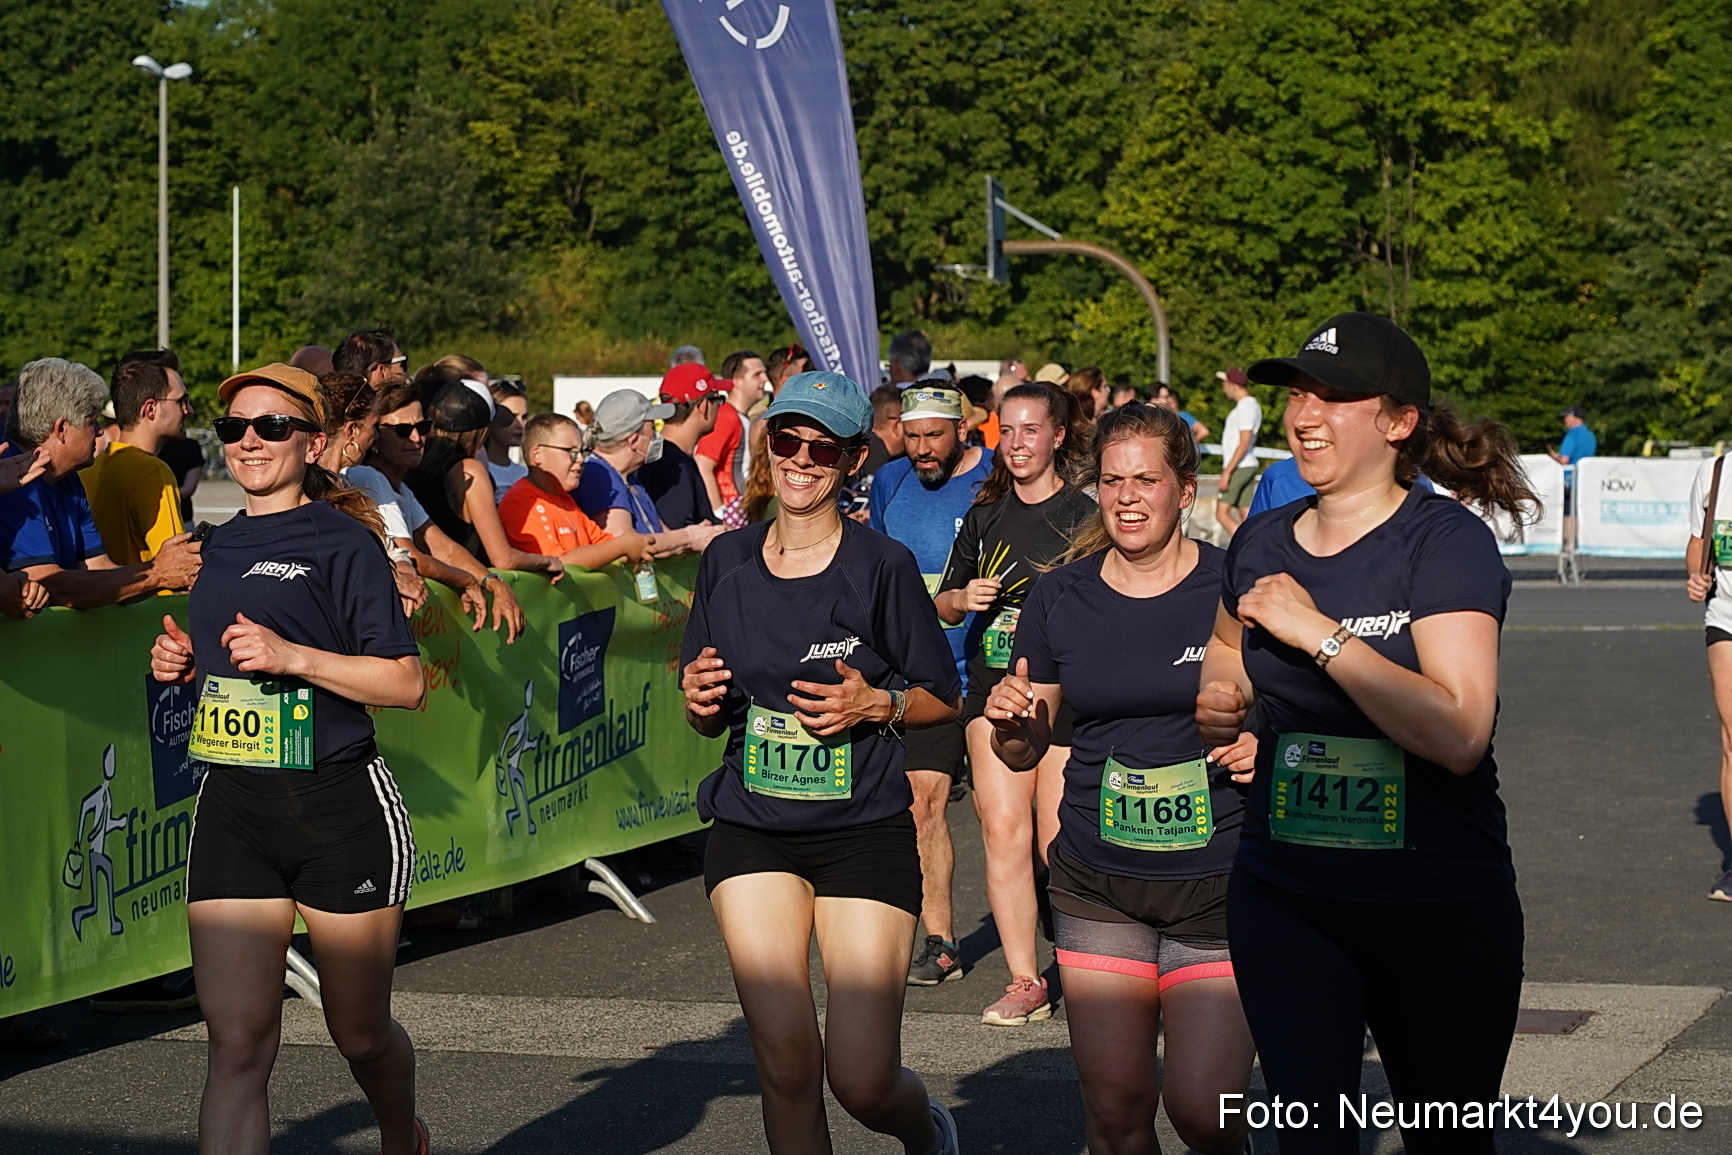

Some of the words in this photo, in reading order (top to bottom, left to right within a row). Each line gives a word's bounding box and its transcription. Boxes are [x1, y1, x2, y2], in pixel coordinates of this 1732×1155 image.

[1305, 341, 1338, 355] adidas
[241, 561, 290, 578] JURA
[800, 641, 846, 662] JURA
[199, 704, 261, 738] 1160
[264, 716, 274, 755] 2022
[766, 727, 798, 736] Firmenlauf
[196, 733, 229, 748] Wegerer
[231, 739, 260, 752] Birgit
[534, 681, 650, 796] firmenlauf
[748, 745, 757, 774] RUN
[759, 739, 831, 772] 1170
[834, 748, 845, 787] 2022
[761, 769, 789, 782] Birzer
[791, 774, 827, 786] Agnes
[1291, 772, 1380, 813] 1412
[540, 780, 588, 824] neumarkt
[1105, 798, 1114, 827] RUN
[1115, 794, 1193, 824] 1168
[1195, 795, 1208, 835] 2022
[1276, 782, 1287, 819] RUN
[1383, 784, 1397, 833] 2022
[1113, 820, 1154, 835] Panknin
[1157, 824, 1197, 836] Tatjana
